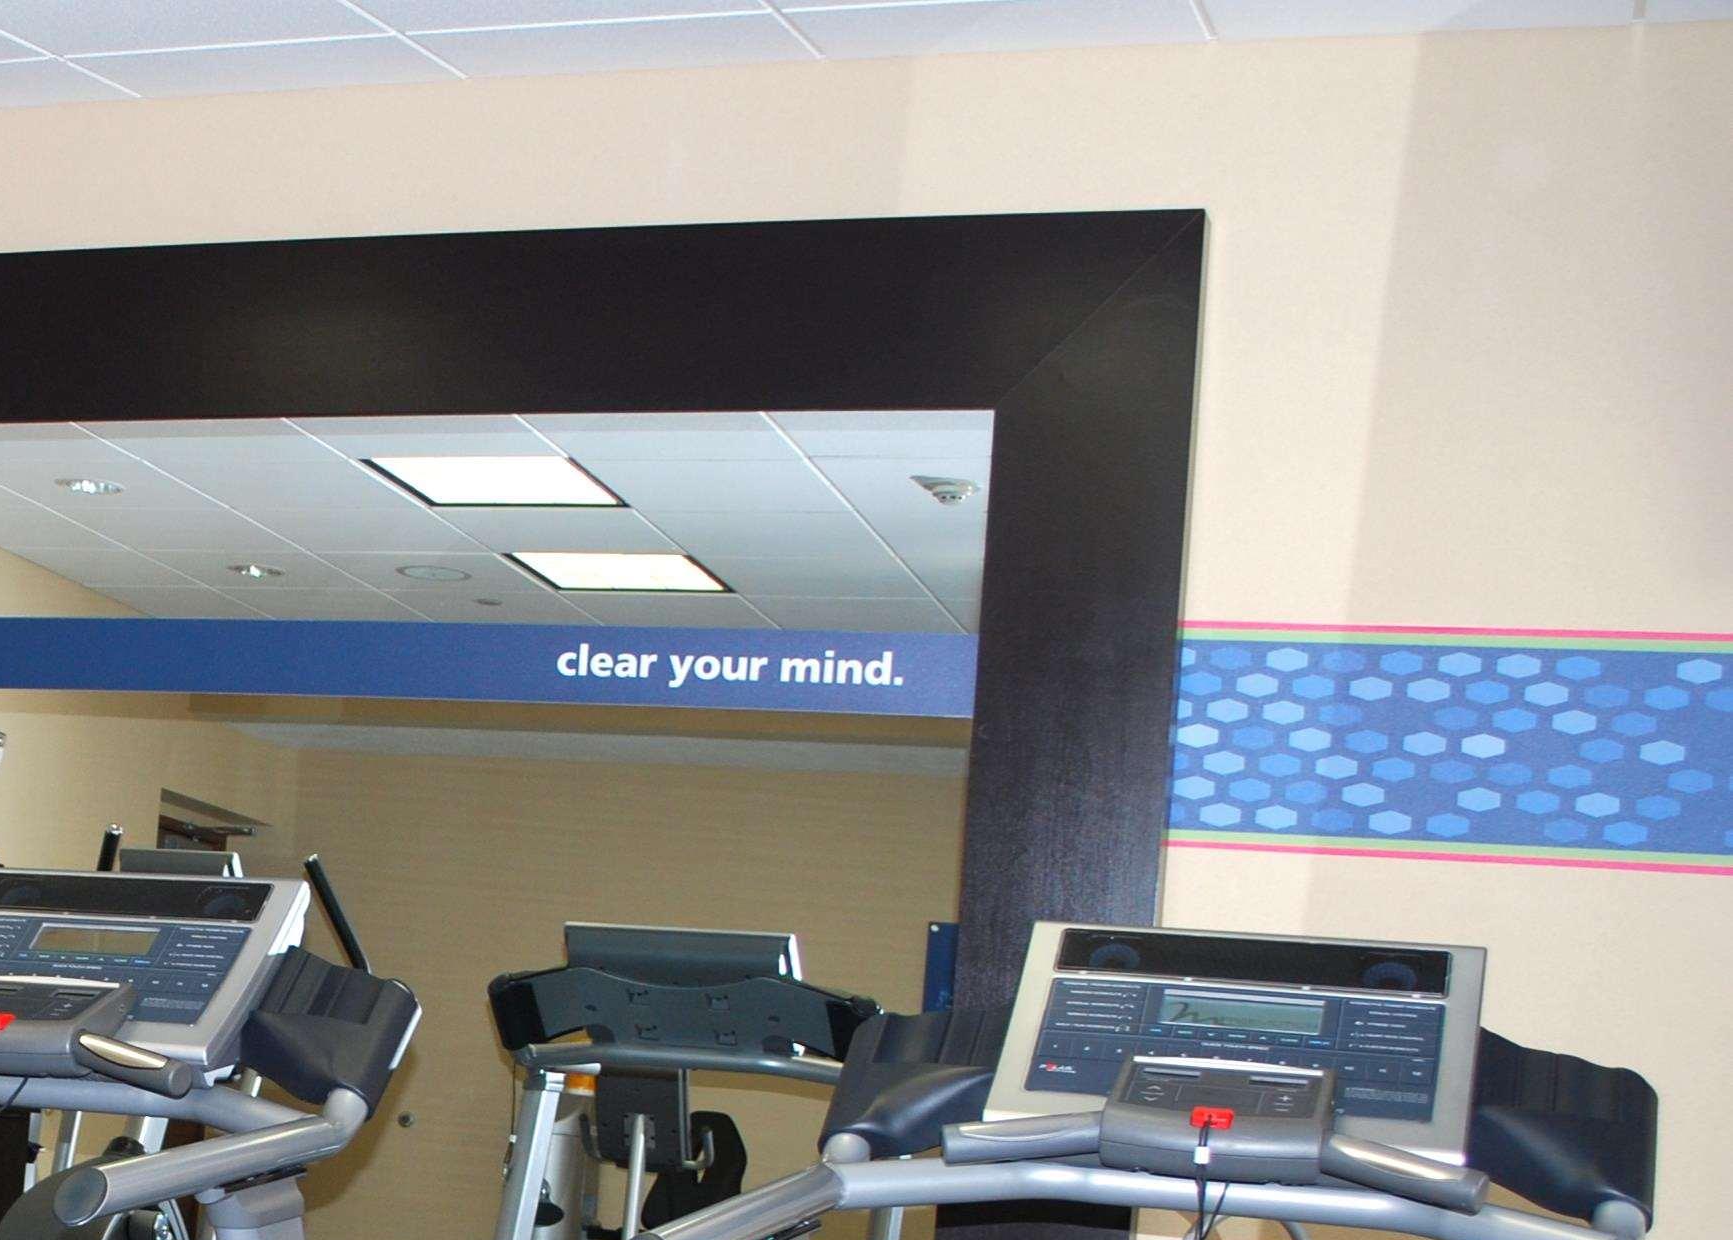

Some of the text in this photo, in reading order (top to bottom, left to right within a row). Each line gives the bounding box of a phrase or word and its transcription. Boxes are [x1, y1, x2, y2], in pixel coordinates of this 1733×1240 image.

[557, 642, 904, 688] clear your mind.
